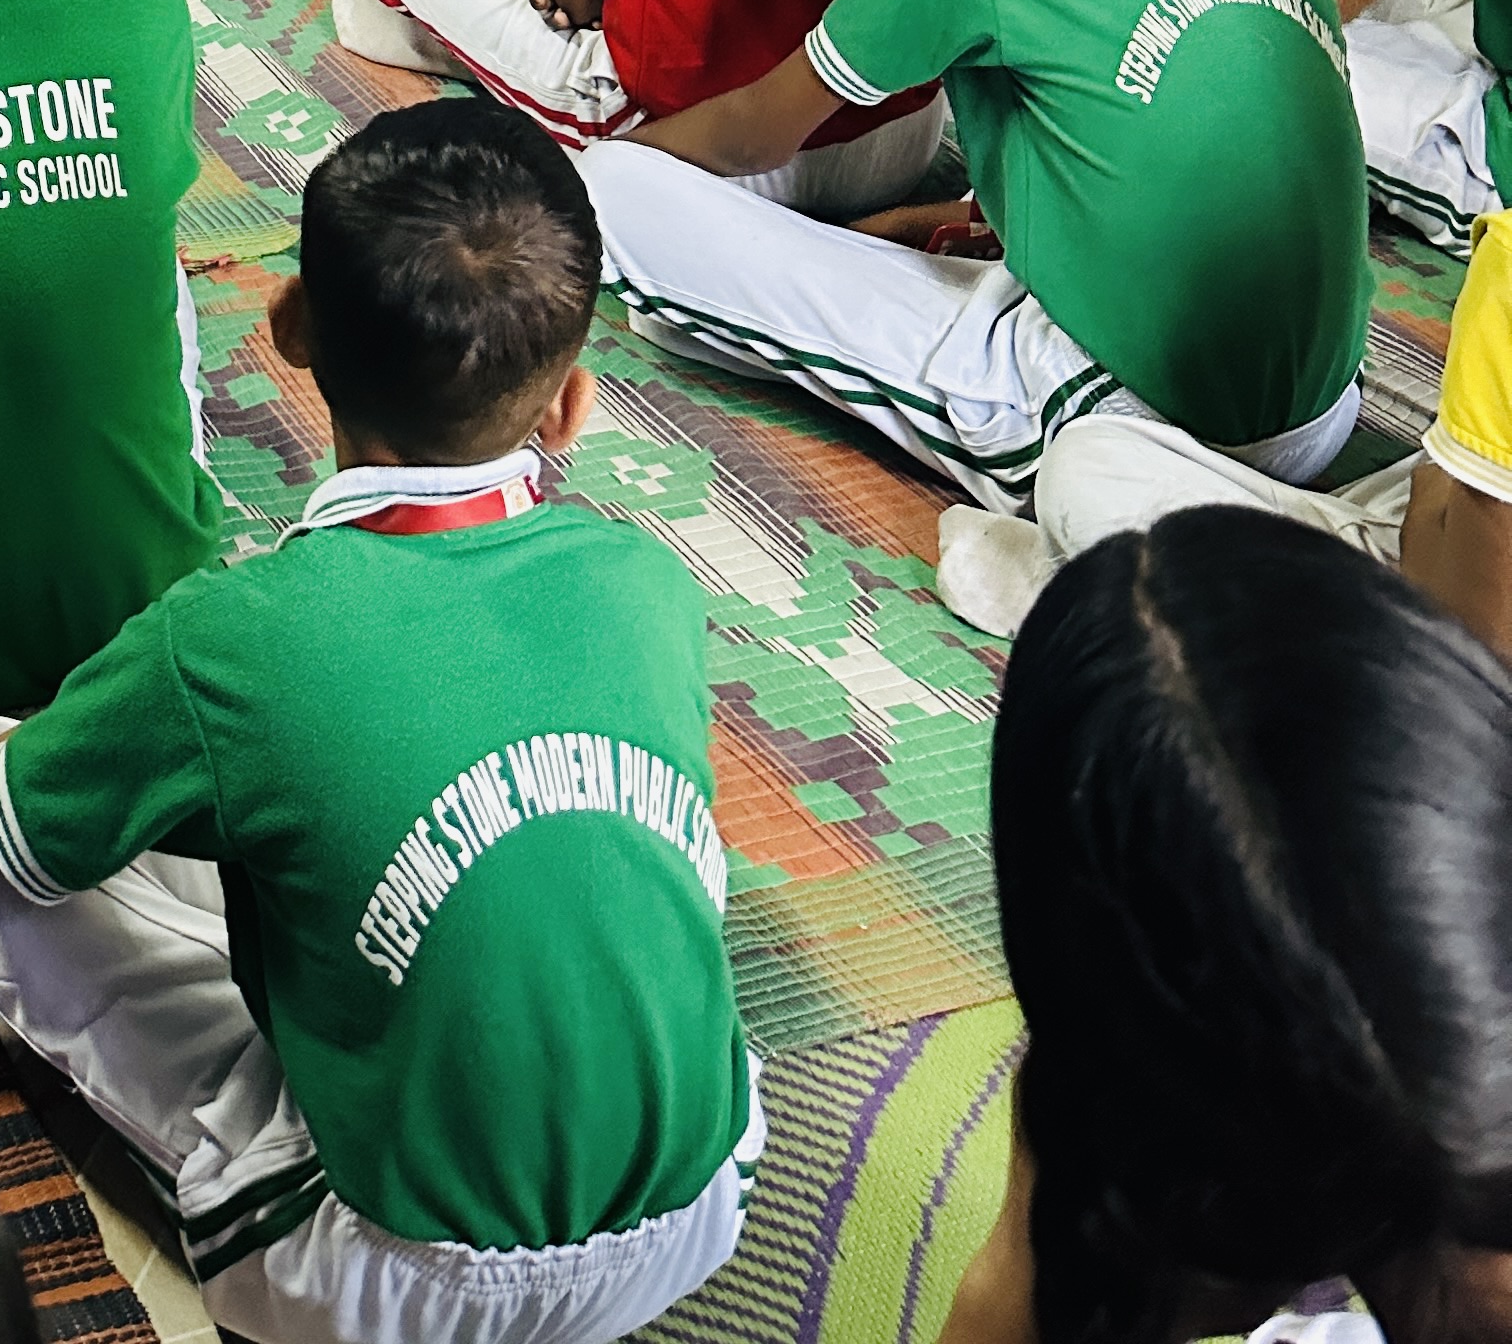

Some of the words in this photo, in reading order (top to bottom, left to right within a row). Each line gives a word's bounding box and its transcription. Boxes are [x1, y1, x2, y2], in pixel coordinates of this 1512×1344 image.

[1115, 2, 1181, 105] STEPPING
[19, 152, 128, 204] SCHOOL
[355, 816, 459, 987] STEPPING
[431, 751, 522, 869] STONE
[505, 732, 616, 820] MODERN
[619, 740, 696, 851] PUBLIC
